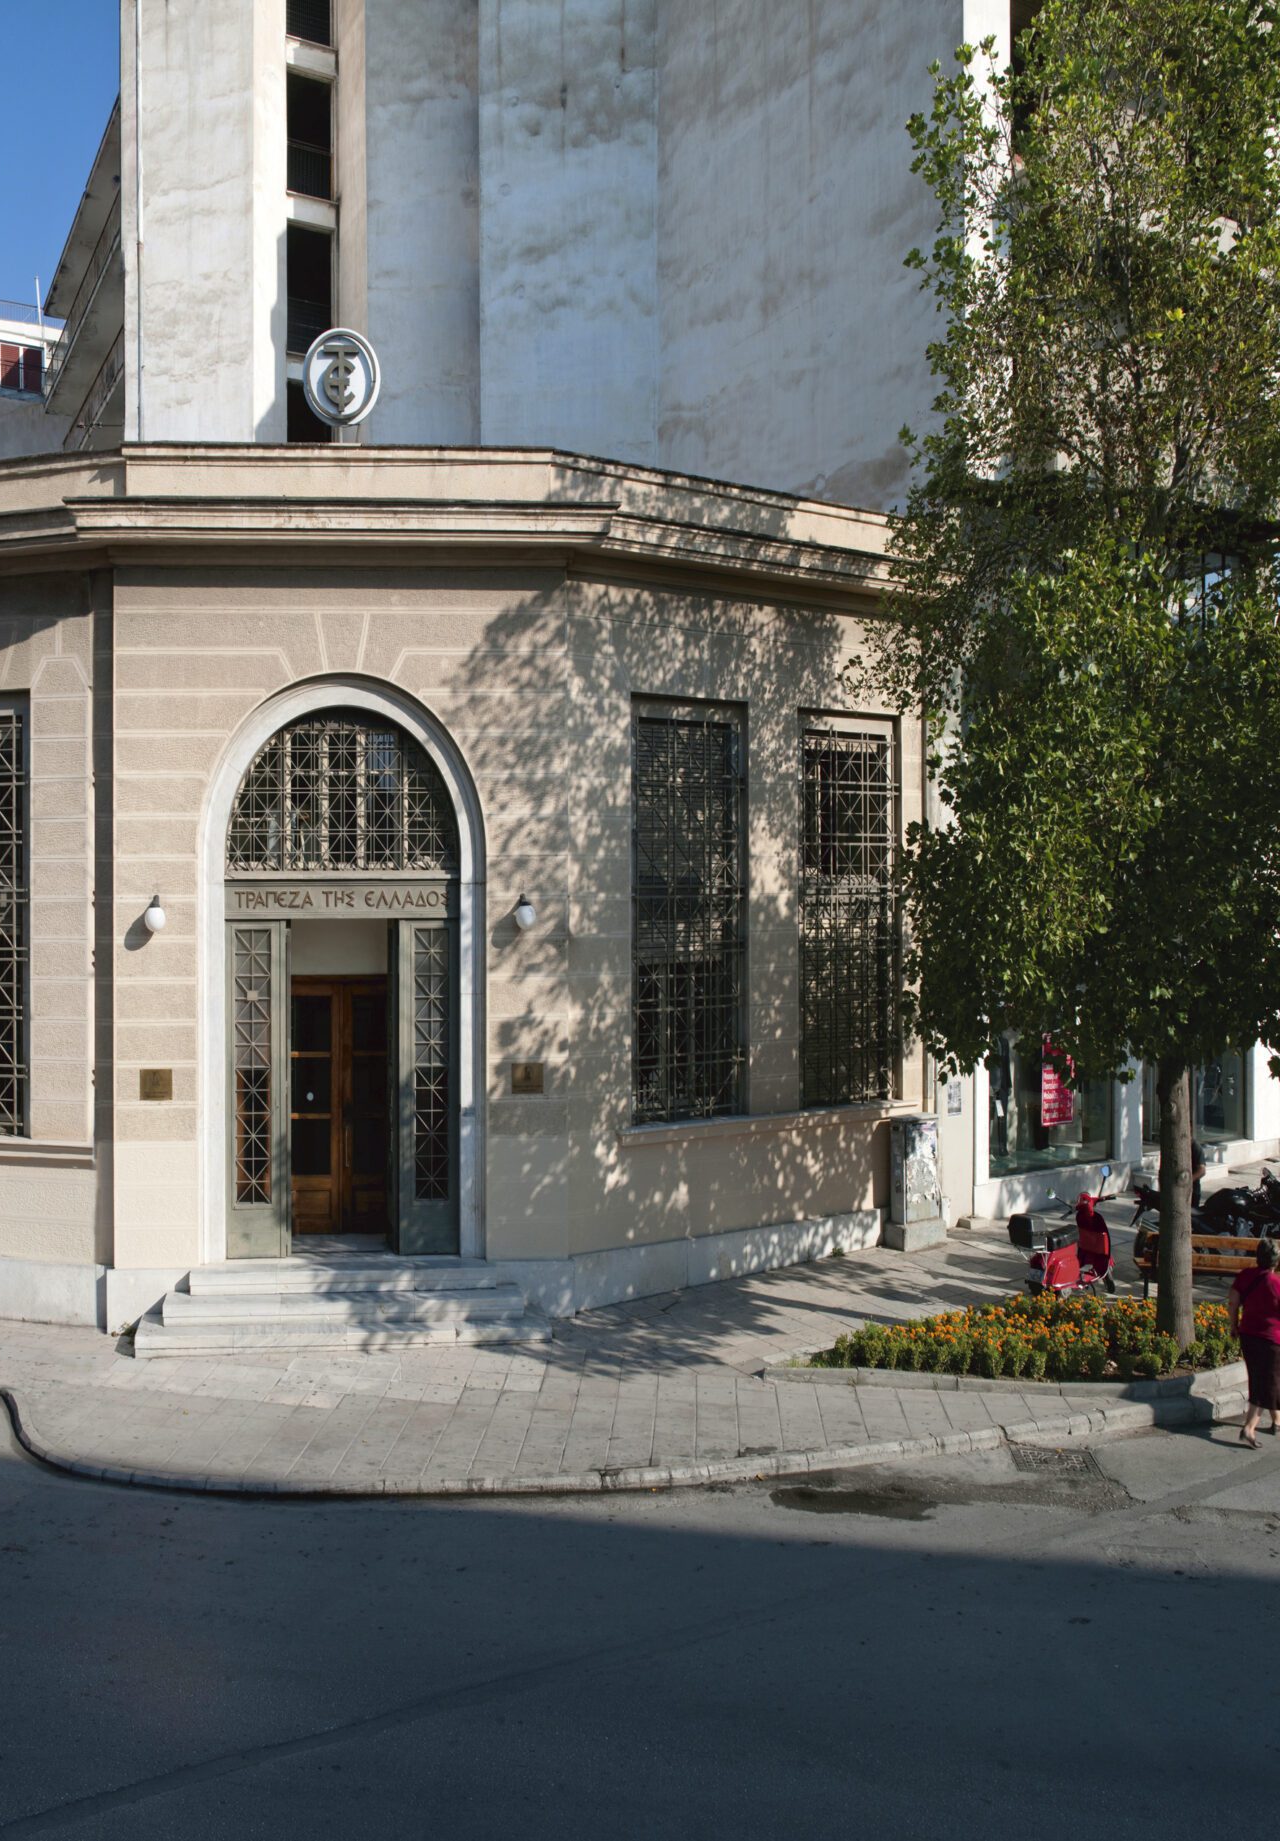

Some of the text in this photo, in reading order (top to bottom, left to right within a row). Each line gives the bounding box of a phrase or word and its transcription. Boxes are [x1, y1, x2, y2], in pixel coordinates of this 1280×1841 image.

[235, 890, 450, 909] ΤΡΑΠΕΖΑ ΤΗΣ ΕΛΛΑΔΟΣ
